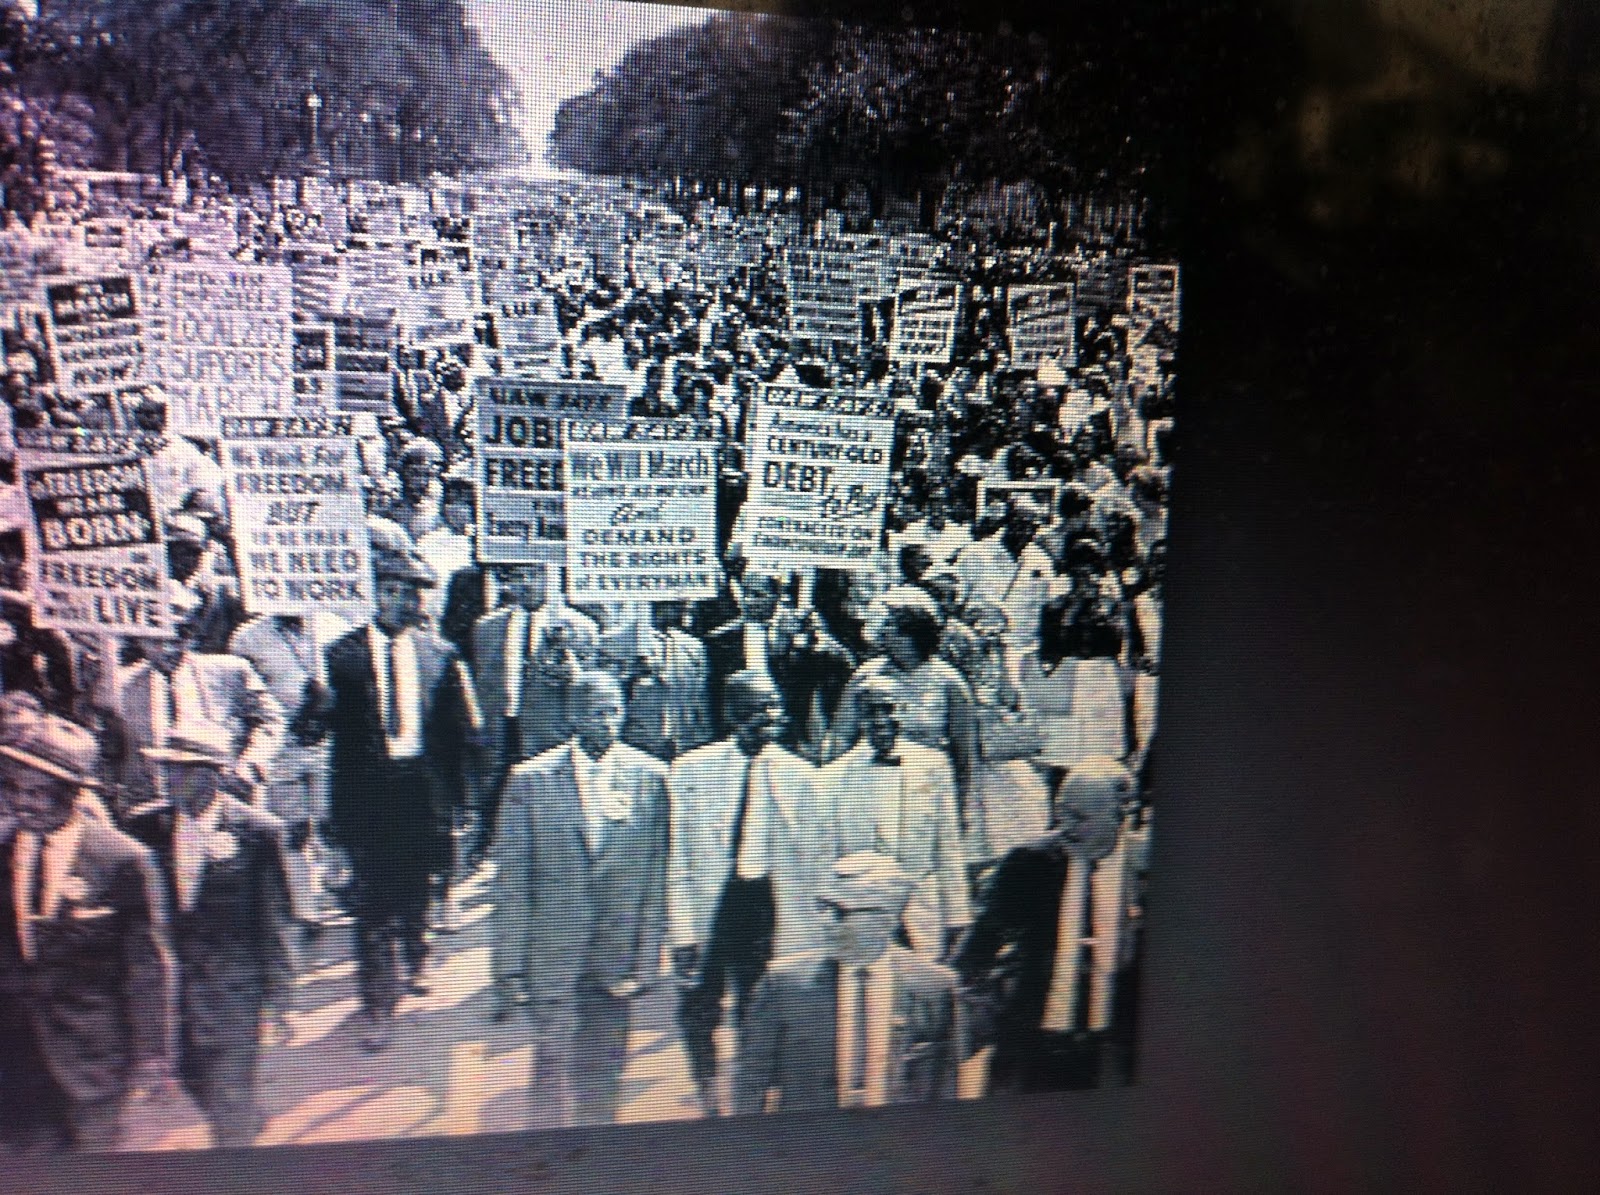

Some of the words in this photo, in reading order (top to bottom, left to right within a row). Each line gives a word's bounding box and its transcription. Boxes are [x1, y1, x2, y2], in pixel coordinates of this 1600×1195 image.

[581, 526, 697, 546] DEMAND
[287, 549, 361, 574] NEED
[284, 578, 367, 602] WORK
